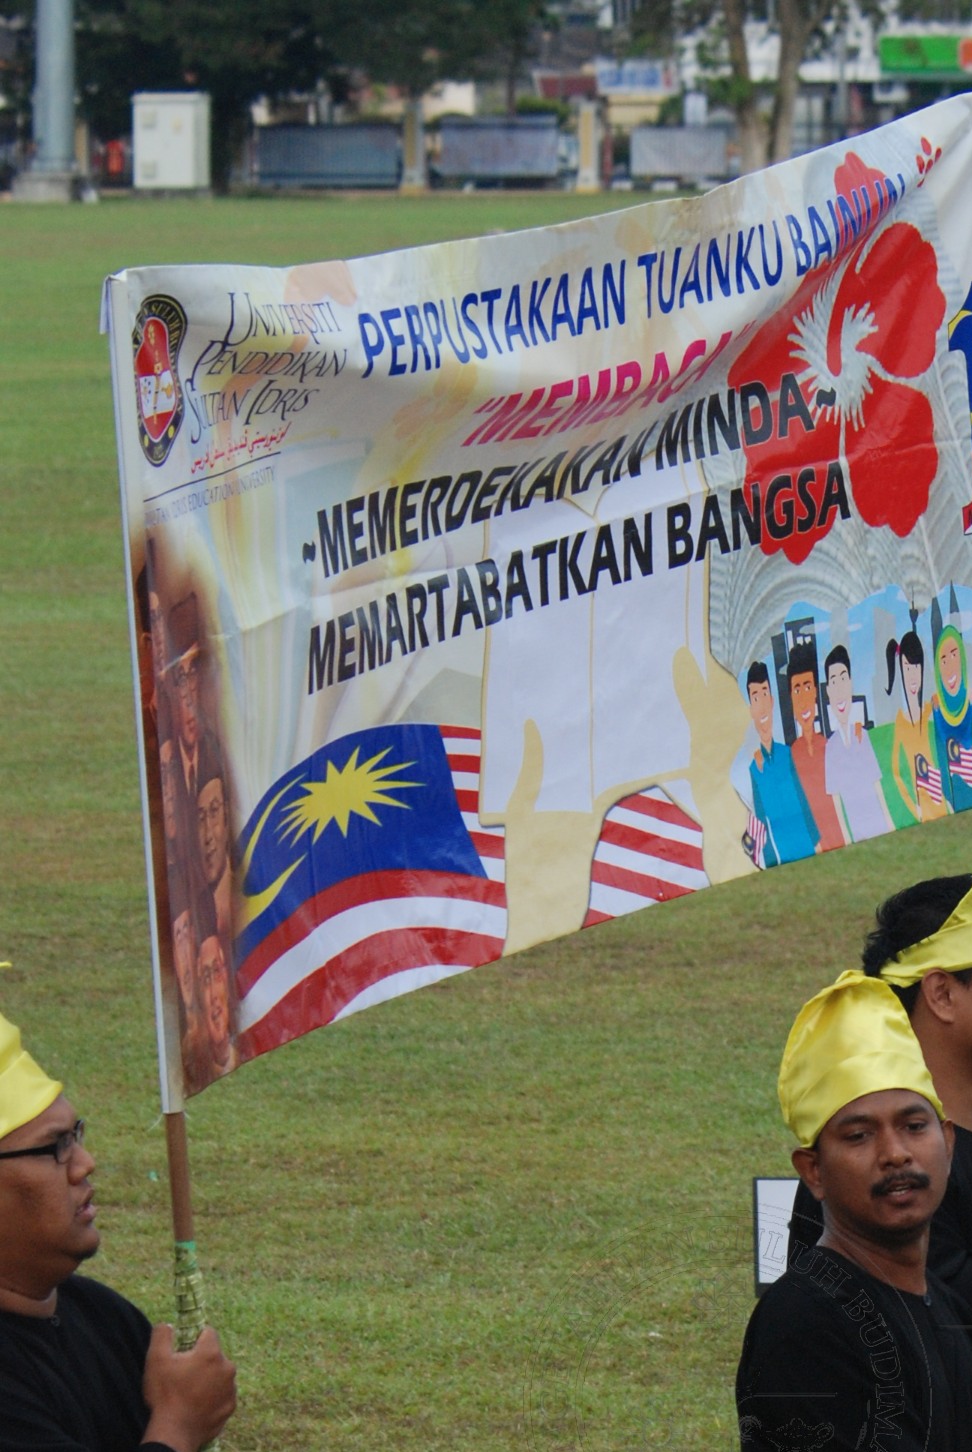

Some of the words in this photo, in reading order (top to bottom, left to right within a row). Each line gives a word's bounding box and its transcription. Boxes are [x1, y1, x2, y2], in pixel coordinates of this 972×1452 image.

[227, 291, 343, 347] UNIVERSITI
[358, 260, 626, 378] PERPUSTAKAAN
[637, 230, 783, 319] TUANKU
[191, 340, 348, 392] PENDIDIKAN
[243, 379, 321, 426] IDRIS
[308, 512, 653, 695] MEMARTABATKAN
[667, 461, 851, 570] BANGSA
